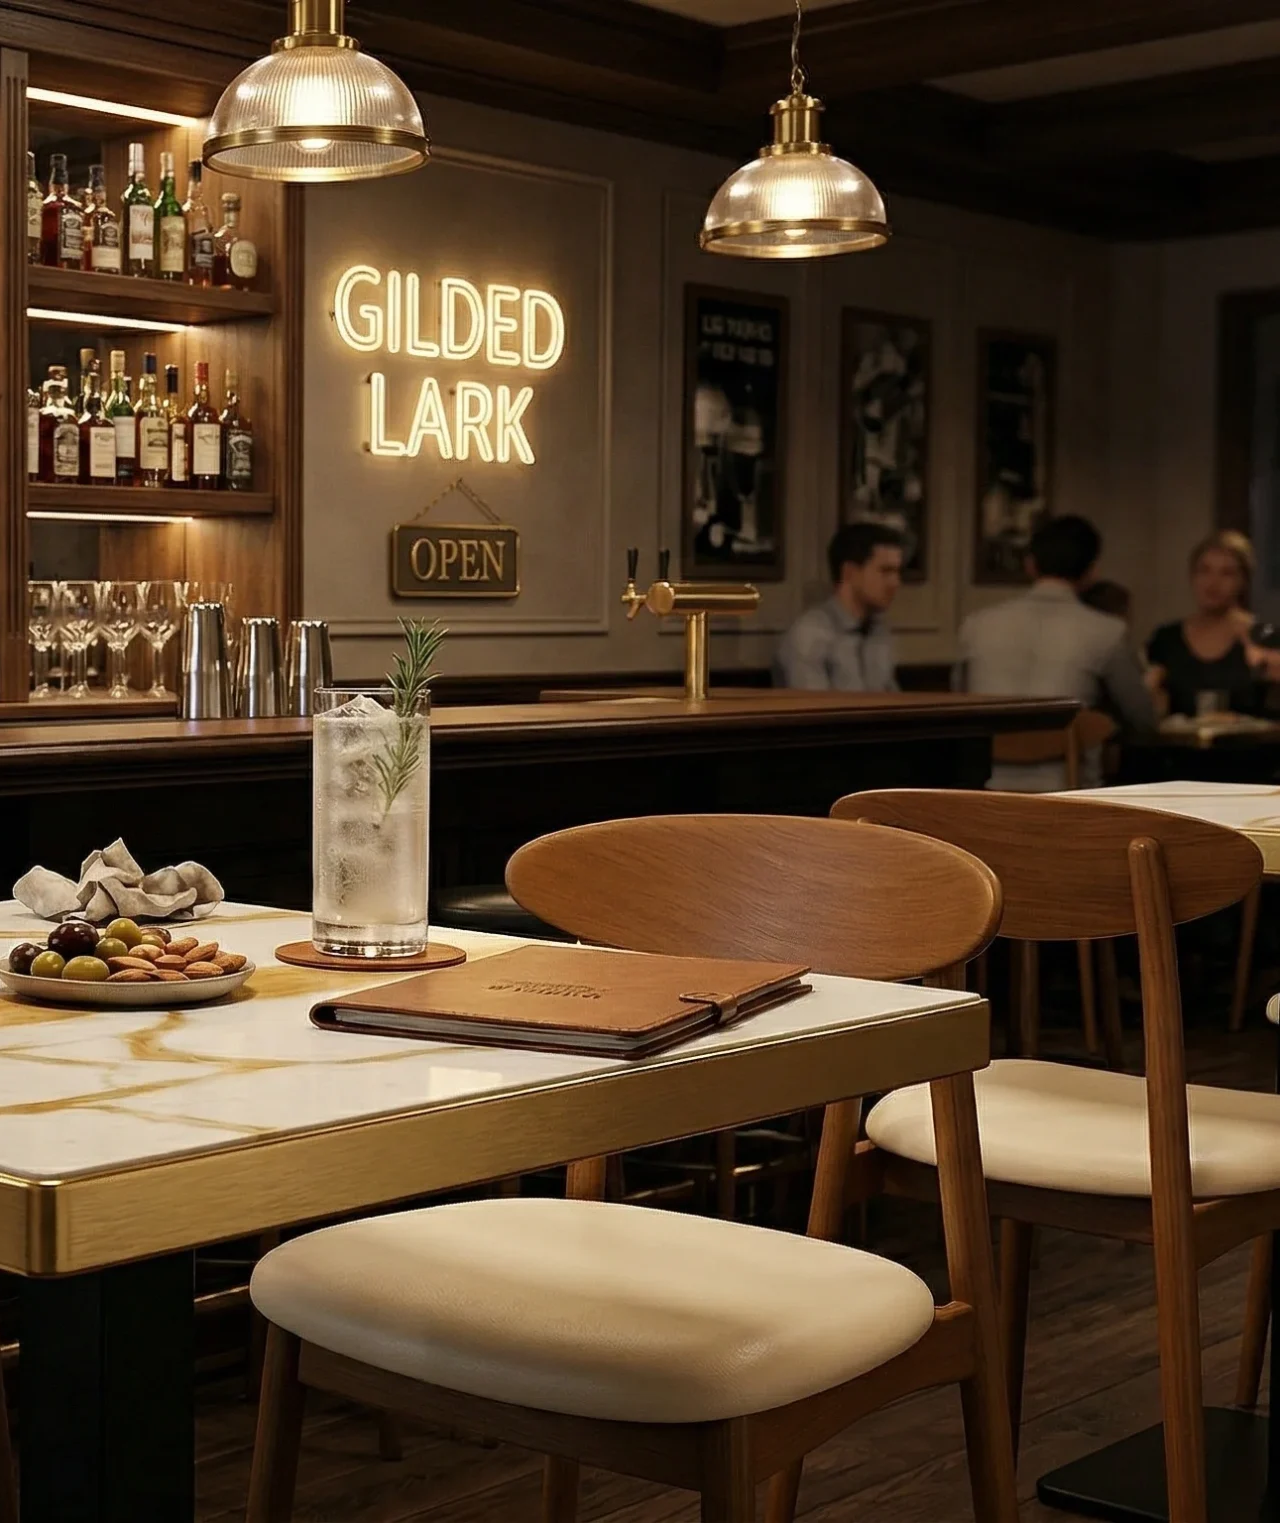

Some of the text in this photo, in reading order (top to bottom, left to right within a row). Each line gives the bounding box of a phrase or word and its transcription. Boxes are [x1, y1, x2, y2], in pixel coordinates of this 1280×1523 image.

[334, 264, 565, 370] GILDED
[370, 372, 536, 465] LARK
[411, 537, 506, 582] OPEN
